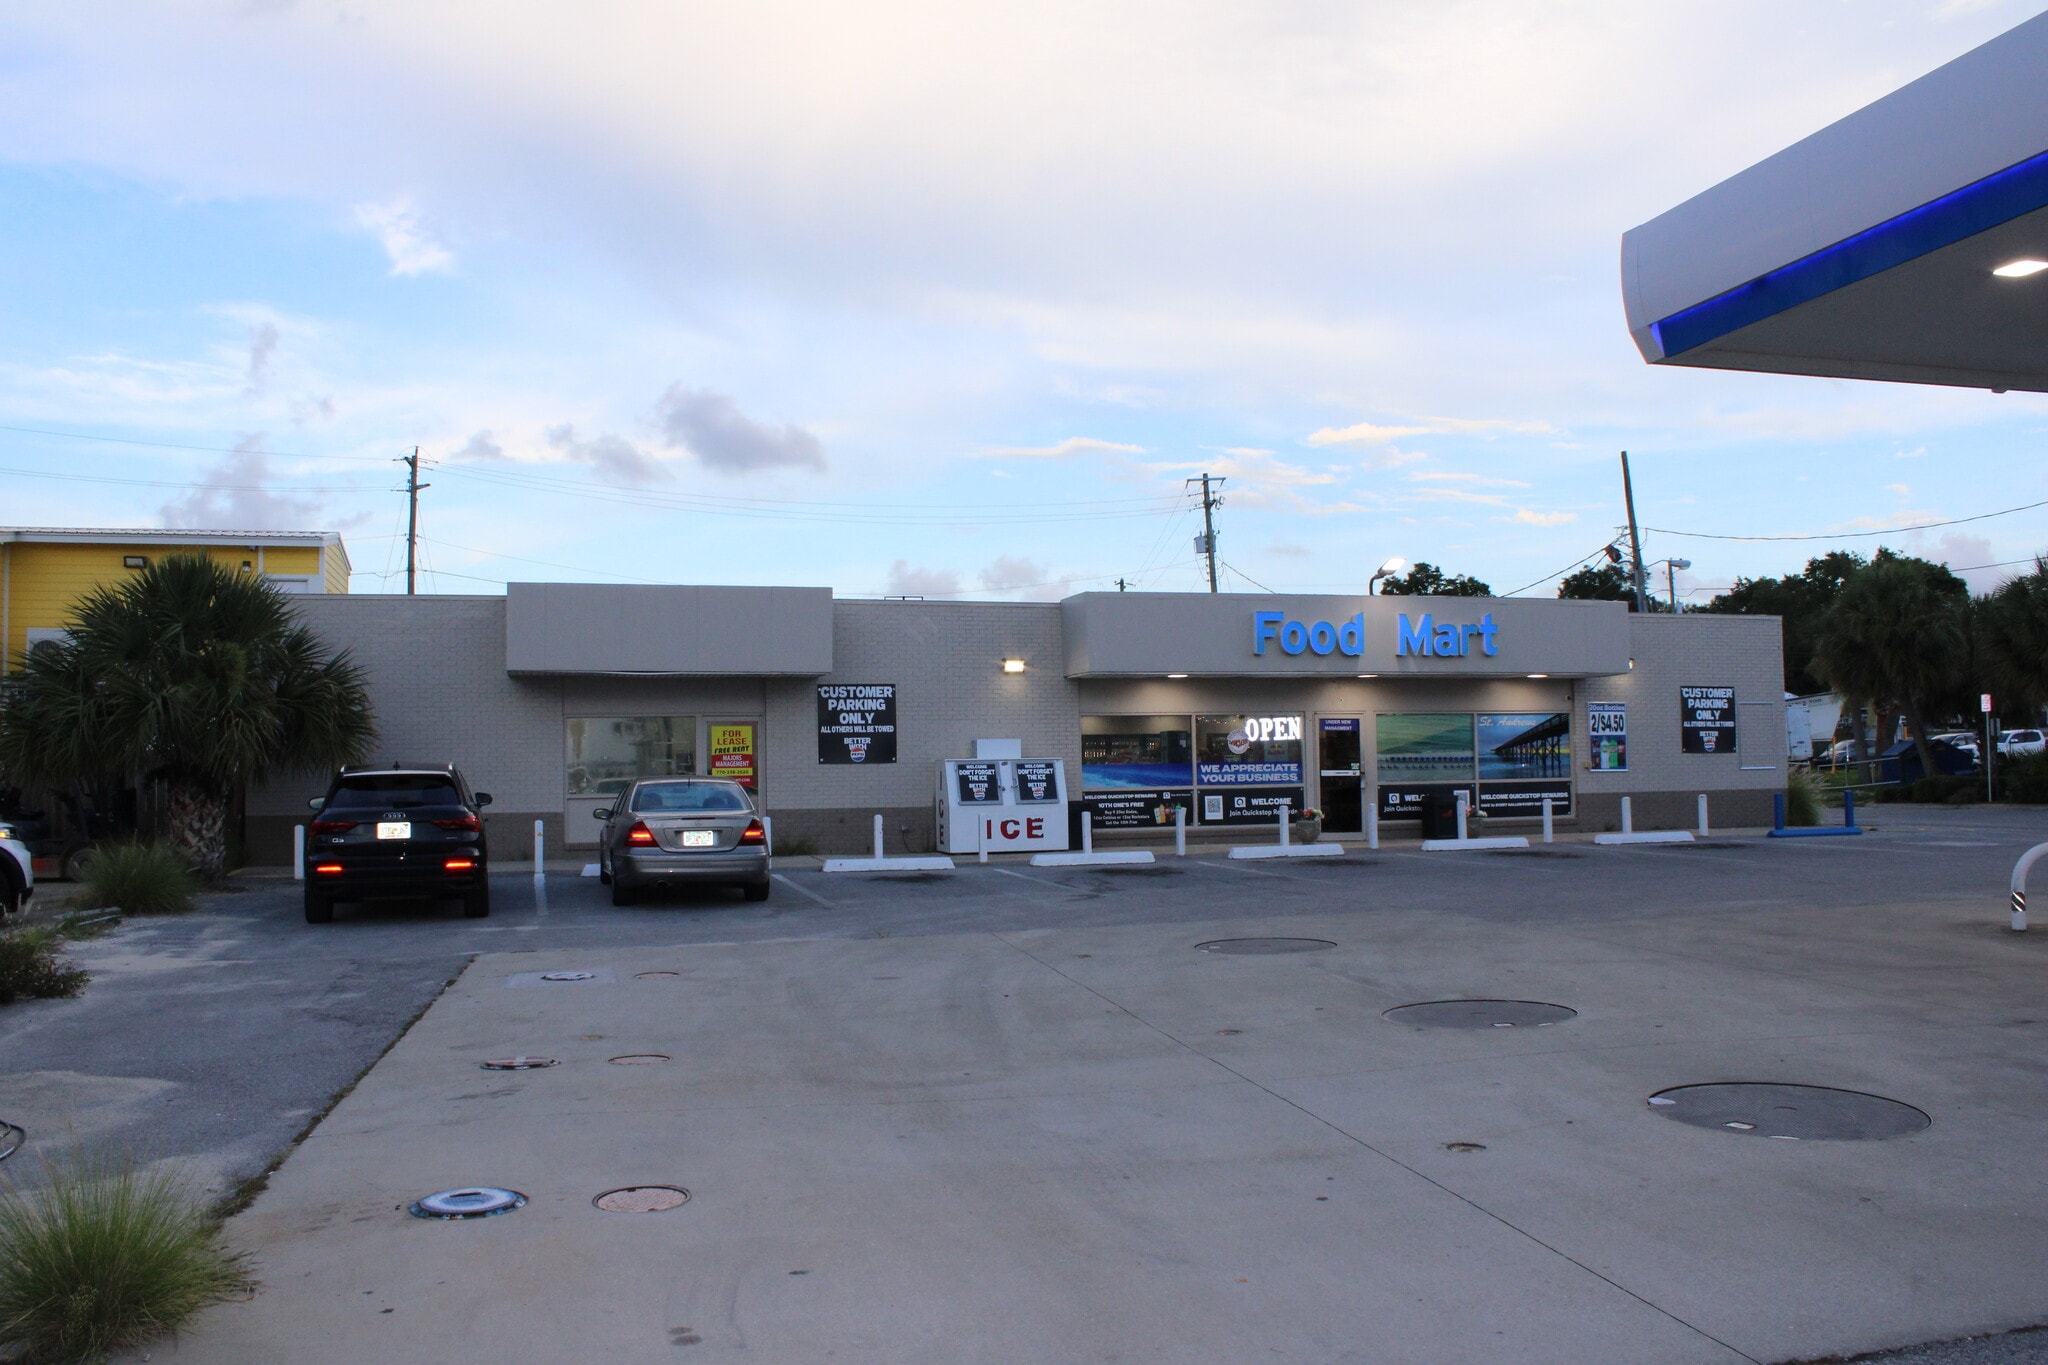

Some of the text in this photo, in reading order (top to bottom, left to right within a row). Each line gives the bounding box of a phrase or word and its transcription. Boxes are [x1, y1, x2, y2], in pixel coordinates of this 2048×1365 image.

[1253, 611, 1498, 657] Food Mart
[820, 686, 892, 698] CUSTOMER
[1682, 688, 1733, 698] CUSTOMER
[828, 699, 886, 710] PARKING
[1687, 698, 1728, 708] PARKING
[839, 712, 875, 724] ONLY
[1695, 710, 1720, 720] ONLY
[1479, 716, 1493, 726] St.
[1591, 713, 1624, 733] 2/$4.50
[854, 725, 866, 733] WILL
[1245, 717, 1300, 741] OPEN
[1222, 764, 1298, 772] APPRECIATE
[1201, 773, 1298, 782] YOUR BUSINESS
[1250, 797, 1292, 805] WELCOME
[1242, 809, 1271, 817] Quickstop
[986, 818, 1044, 839] ICE
